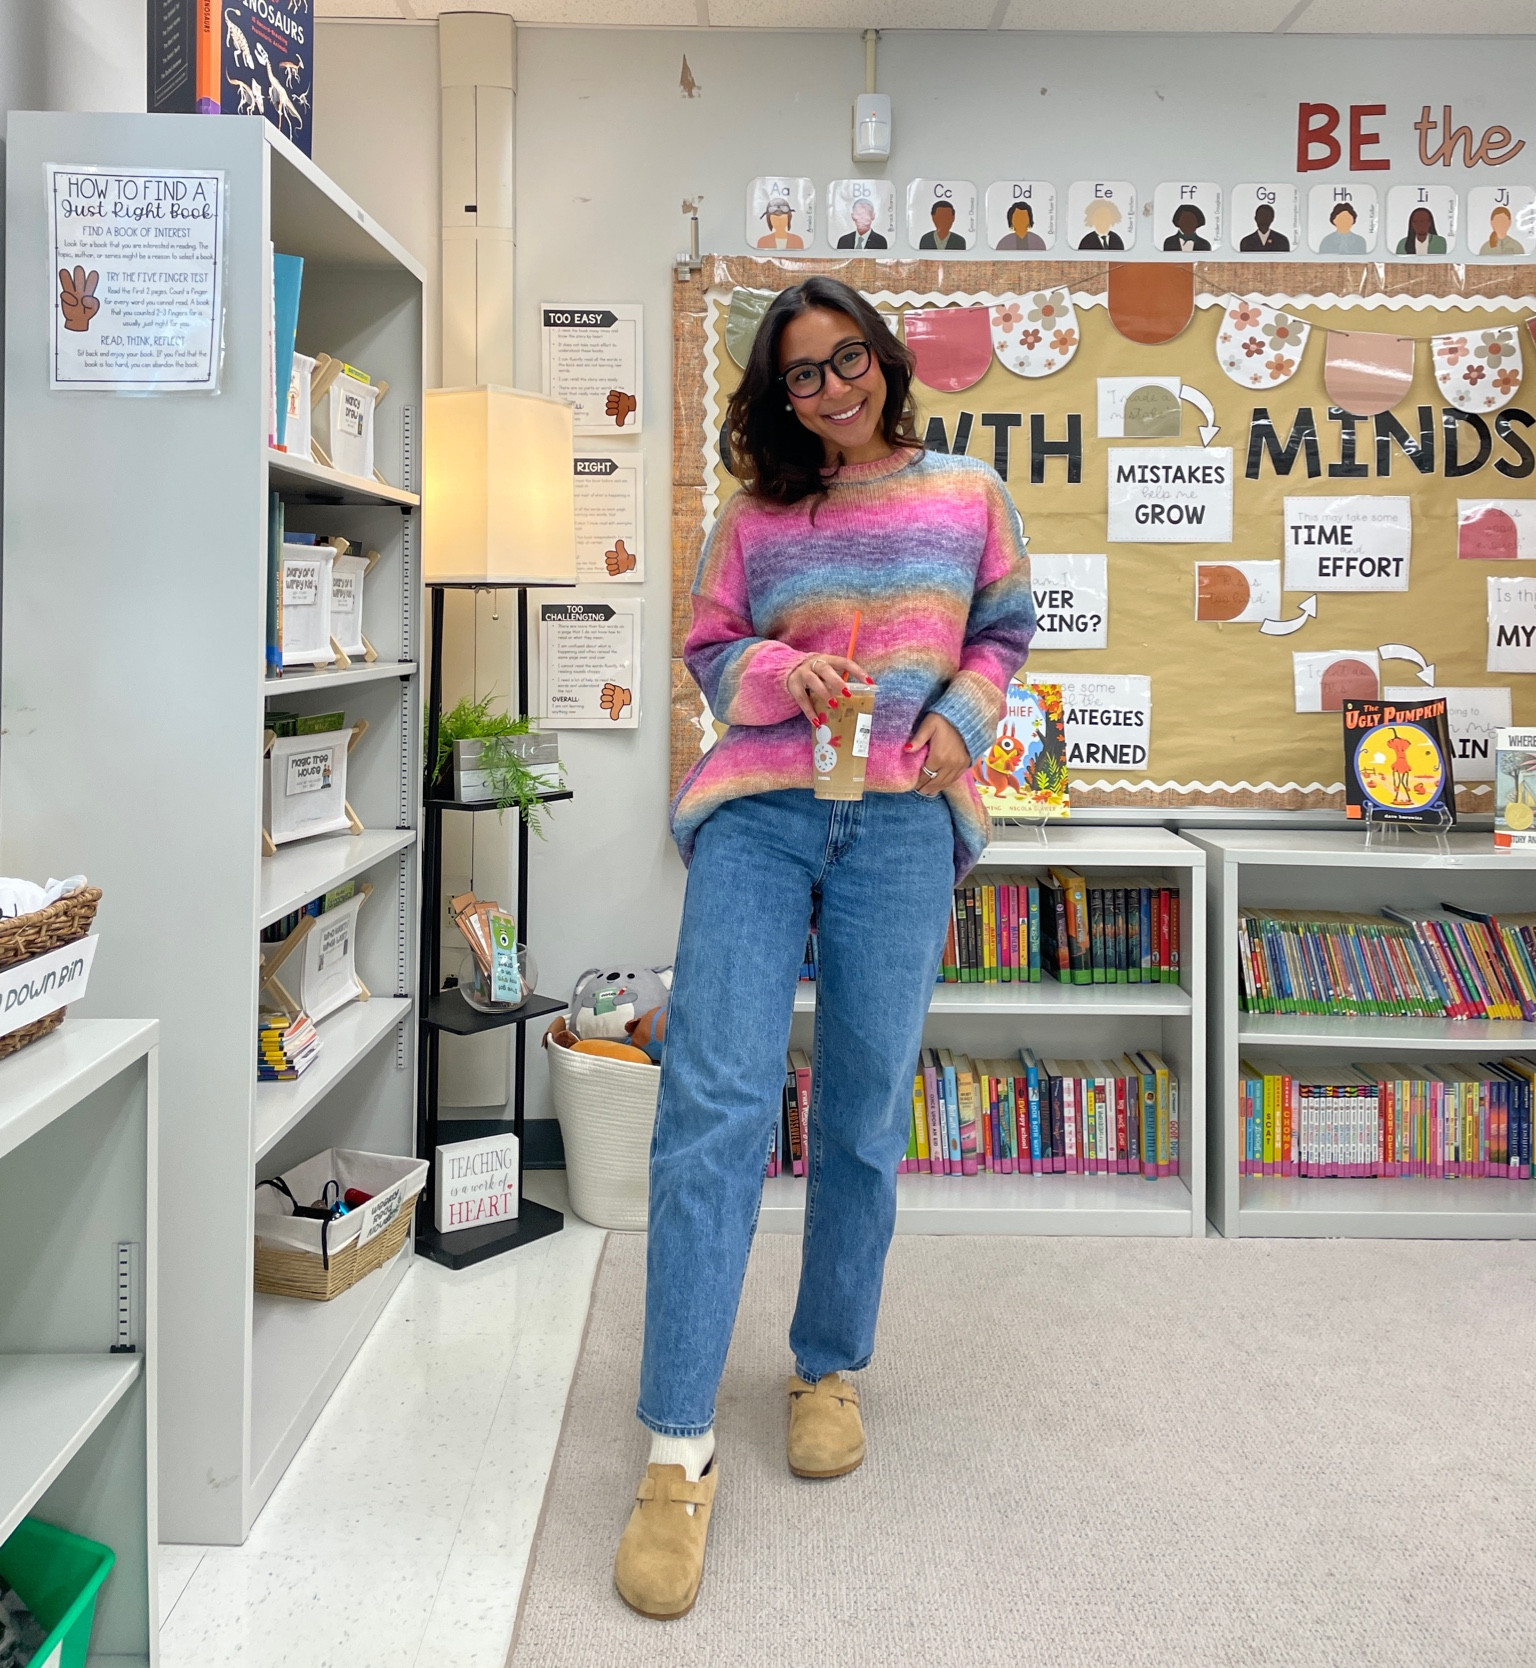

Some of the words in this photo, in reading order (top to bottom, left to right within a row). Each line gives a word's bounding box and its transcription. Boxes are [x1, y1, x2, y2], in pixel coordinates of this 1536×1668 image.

[1296, 102, 1390, 172] BE
[1414, 104, 1526, 168] the
[68, 178, 108, 200] HOW
[114, 180, 138, 200] TO
[144, 180, 187, 201] FIND
[192, 181, 206, 202] A
[770, 182, 790, 196] Aa
[852, 184, 871, 198] Bb
[934, 184, 952, 198] Cc
[1012, 184, 1032, 198] Dd
[1094, 184, 1113, 198] Ee
[1180, 185, 1197, 200] Ff
[1254, 186, 1274, 204] Gg
[1332, 187, 1350, 202] Hh
[1416, 188, 1427, 202] Ii
[1492, 188, 1508, 206] Jj
[61, 199, 108, 218] Just
[112, 202, 166, 221] Right
[170, 203, 214, 220] Book
[82, 226, 104, 236] FIND
[106, 227, 112, 236] A
[114, 227, 138, 237] BOOK
[140, 228, 150, 238] OF
[154, 228, 191, 238] INTEREST
[64, 239, 76, 247] Look
[80, 240, 88, 248] for
[94, 240, 107, 248] book
[198, 241, 208, 250] The
[106, 272, 120, 282] TRY
[122, 272, 136, 282] THE
[138, 272, 156, 283] FIVE
[159, 272, 189, 283] FINGER
[190, 272, 208, 283] TEST
[190, 288, 208, 296] finger
[156, 298, 174, 306] cannot
[196, 298, 210, 306] book
[548, 313, 570, 324] TOO
[574, 314, 602, 324] EASY
[100, 335, 124, 346] READ,
[126, 335, 152, 346] THINK,
[154, 335, 185, 346] REFLECT
[344, 394, 360, 410] Nancy
[346, 406, 358, 420] Drew
[922, 411, 1082, 484] WTH
[1244, 404, 1536, 480] MINDS
[576, 462, 612, 472] RIGHT
[1116, 464, 1225, 485] MISTAKES
[1141, 485, 1174, 501] help
[1178, 491, 1198, 500] me
[1135, 504, 1206, 524] GROW
[1298, 512, 1320, 522] This
[1322, 515, 1342, 524] may
[1346, 512, 1368, 522] take
[1370, 514, 1398, 522] some
[1290, 525, 1353, 545] TIME
[1340, 544, 1364, 555] and
[1318, 557, 1404, 578] EFFORT
[1033, 590, 1074, 609] VER
[1497, 588, 1512, 602] Is
[546, 613, 605, 621] CHALLENGING
[1036, 614, 1102, 632] KING?
[1496, 624, 1536, 648] MY
[1062, 684, 1078, 693] se
[1081, 684, 1116, 694] some
[1009, 706, 1033, 717] HIEF
[1066, 708, 1144, 727] ATEGIES
[1346, 710, 1382, 730] UGLY
[1384, 701, 1445, 725] PUMPKIN
[1450, 708, 1468, 718] oing
[1470, 708, 1480, 717] to
[1508, 735, 1536, 748] WHERE
[1068, 742, 1146, 764] ARNED
[1018, 1100, 1026, 1114] EVIL
[1030, 1102, 1038, 1118] LOOK
[789, 1108, 801, 1143] CROSSOVER
[932, 1128, 937, 1136] AN
[1170, 1120, 1178, 1140] GOOD
[1020, 1127, 1028, 1148] school
[1170, 1140, 1178, 1156] DOG
[448, 1148, 512, 1180] TEACHING
[450, 1187, 458, 1196] is
[461, 1186, 468, 1194] a
[471, 1174, 494, 1192] work
[498, 1173, 508, 1192] of
[448, 1192, 512, 1226] HEART
